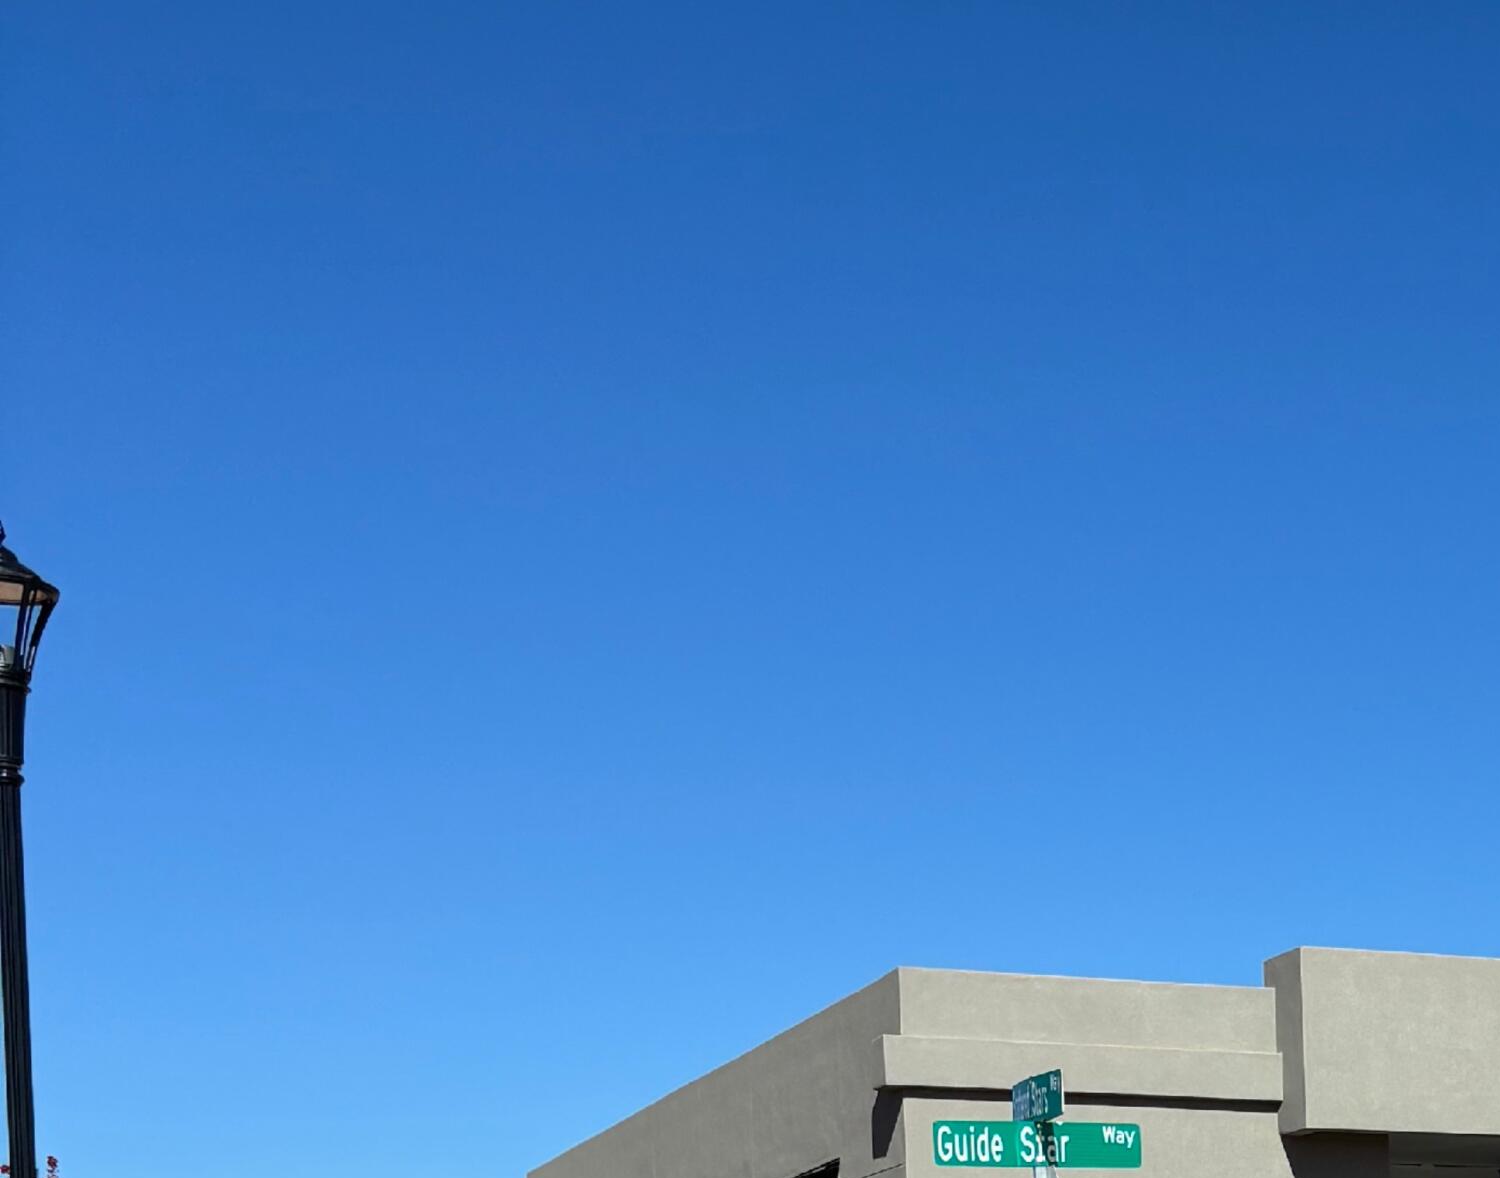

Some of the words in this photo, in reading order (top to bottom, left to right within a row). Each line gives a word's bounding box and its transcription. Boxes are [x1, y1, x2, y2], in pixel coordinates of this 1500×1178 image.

[937, 1125, 1003, 1162] Guide
[1020, 1126, 1070, 1163] Star
[1102, 1126, 1136, 1149] Way
